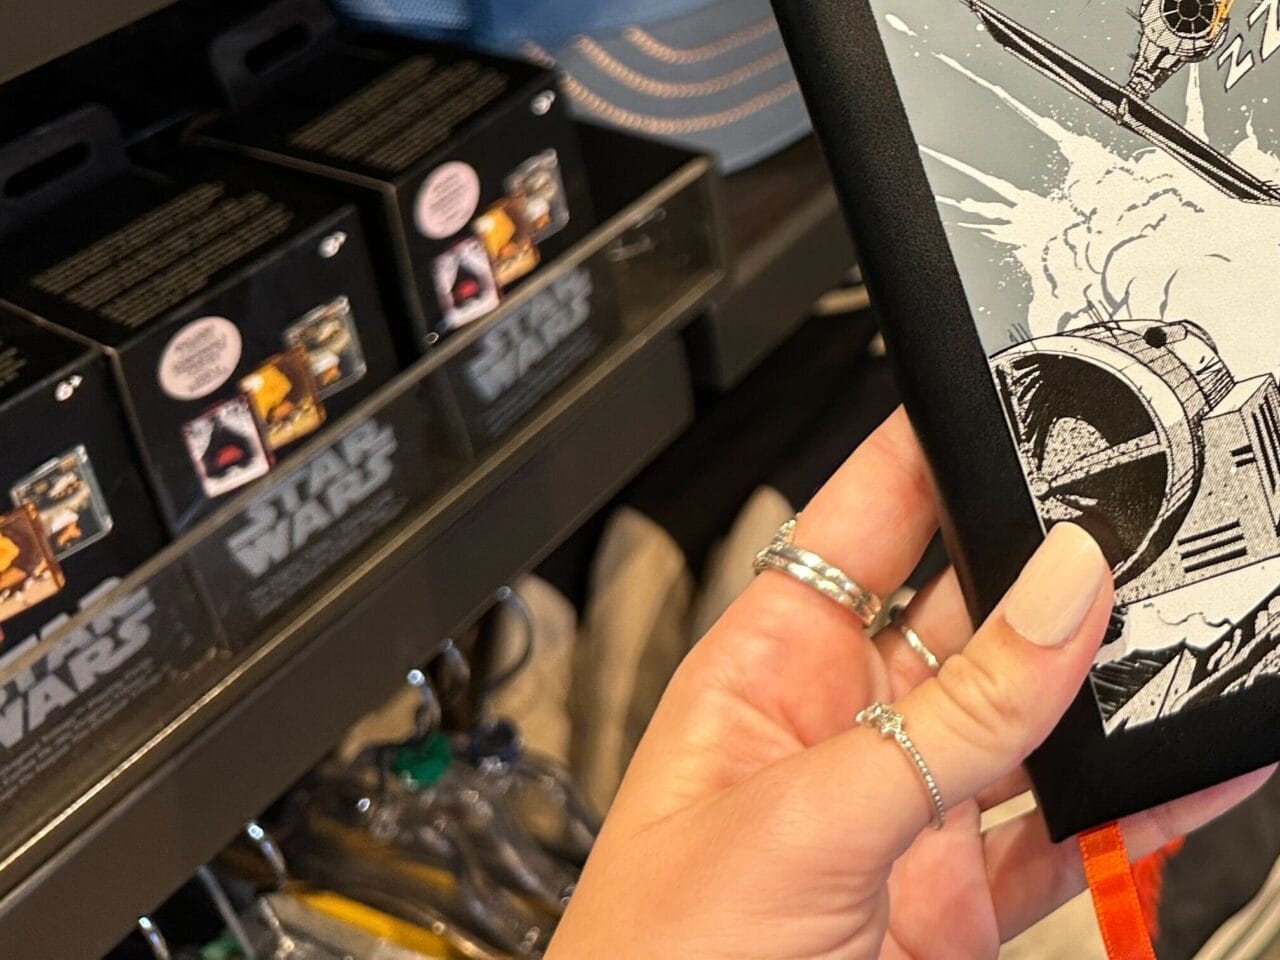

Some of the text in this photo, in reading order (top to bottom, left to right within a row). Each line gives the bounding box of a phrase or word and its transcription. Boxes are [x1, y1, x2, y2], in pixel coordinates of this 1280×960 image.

[227, 414, 395, 549] STAR
[235, 437, 398, 579] WARS
[0, 576, 152, 708] TAR
